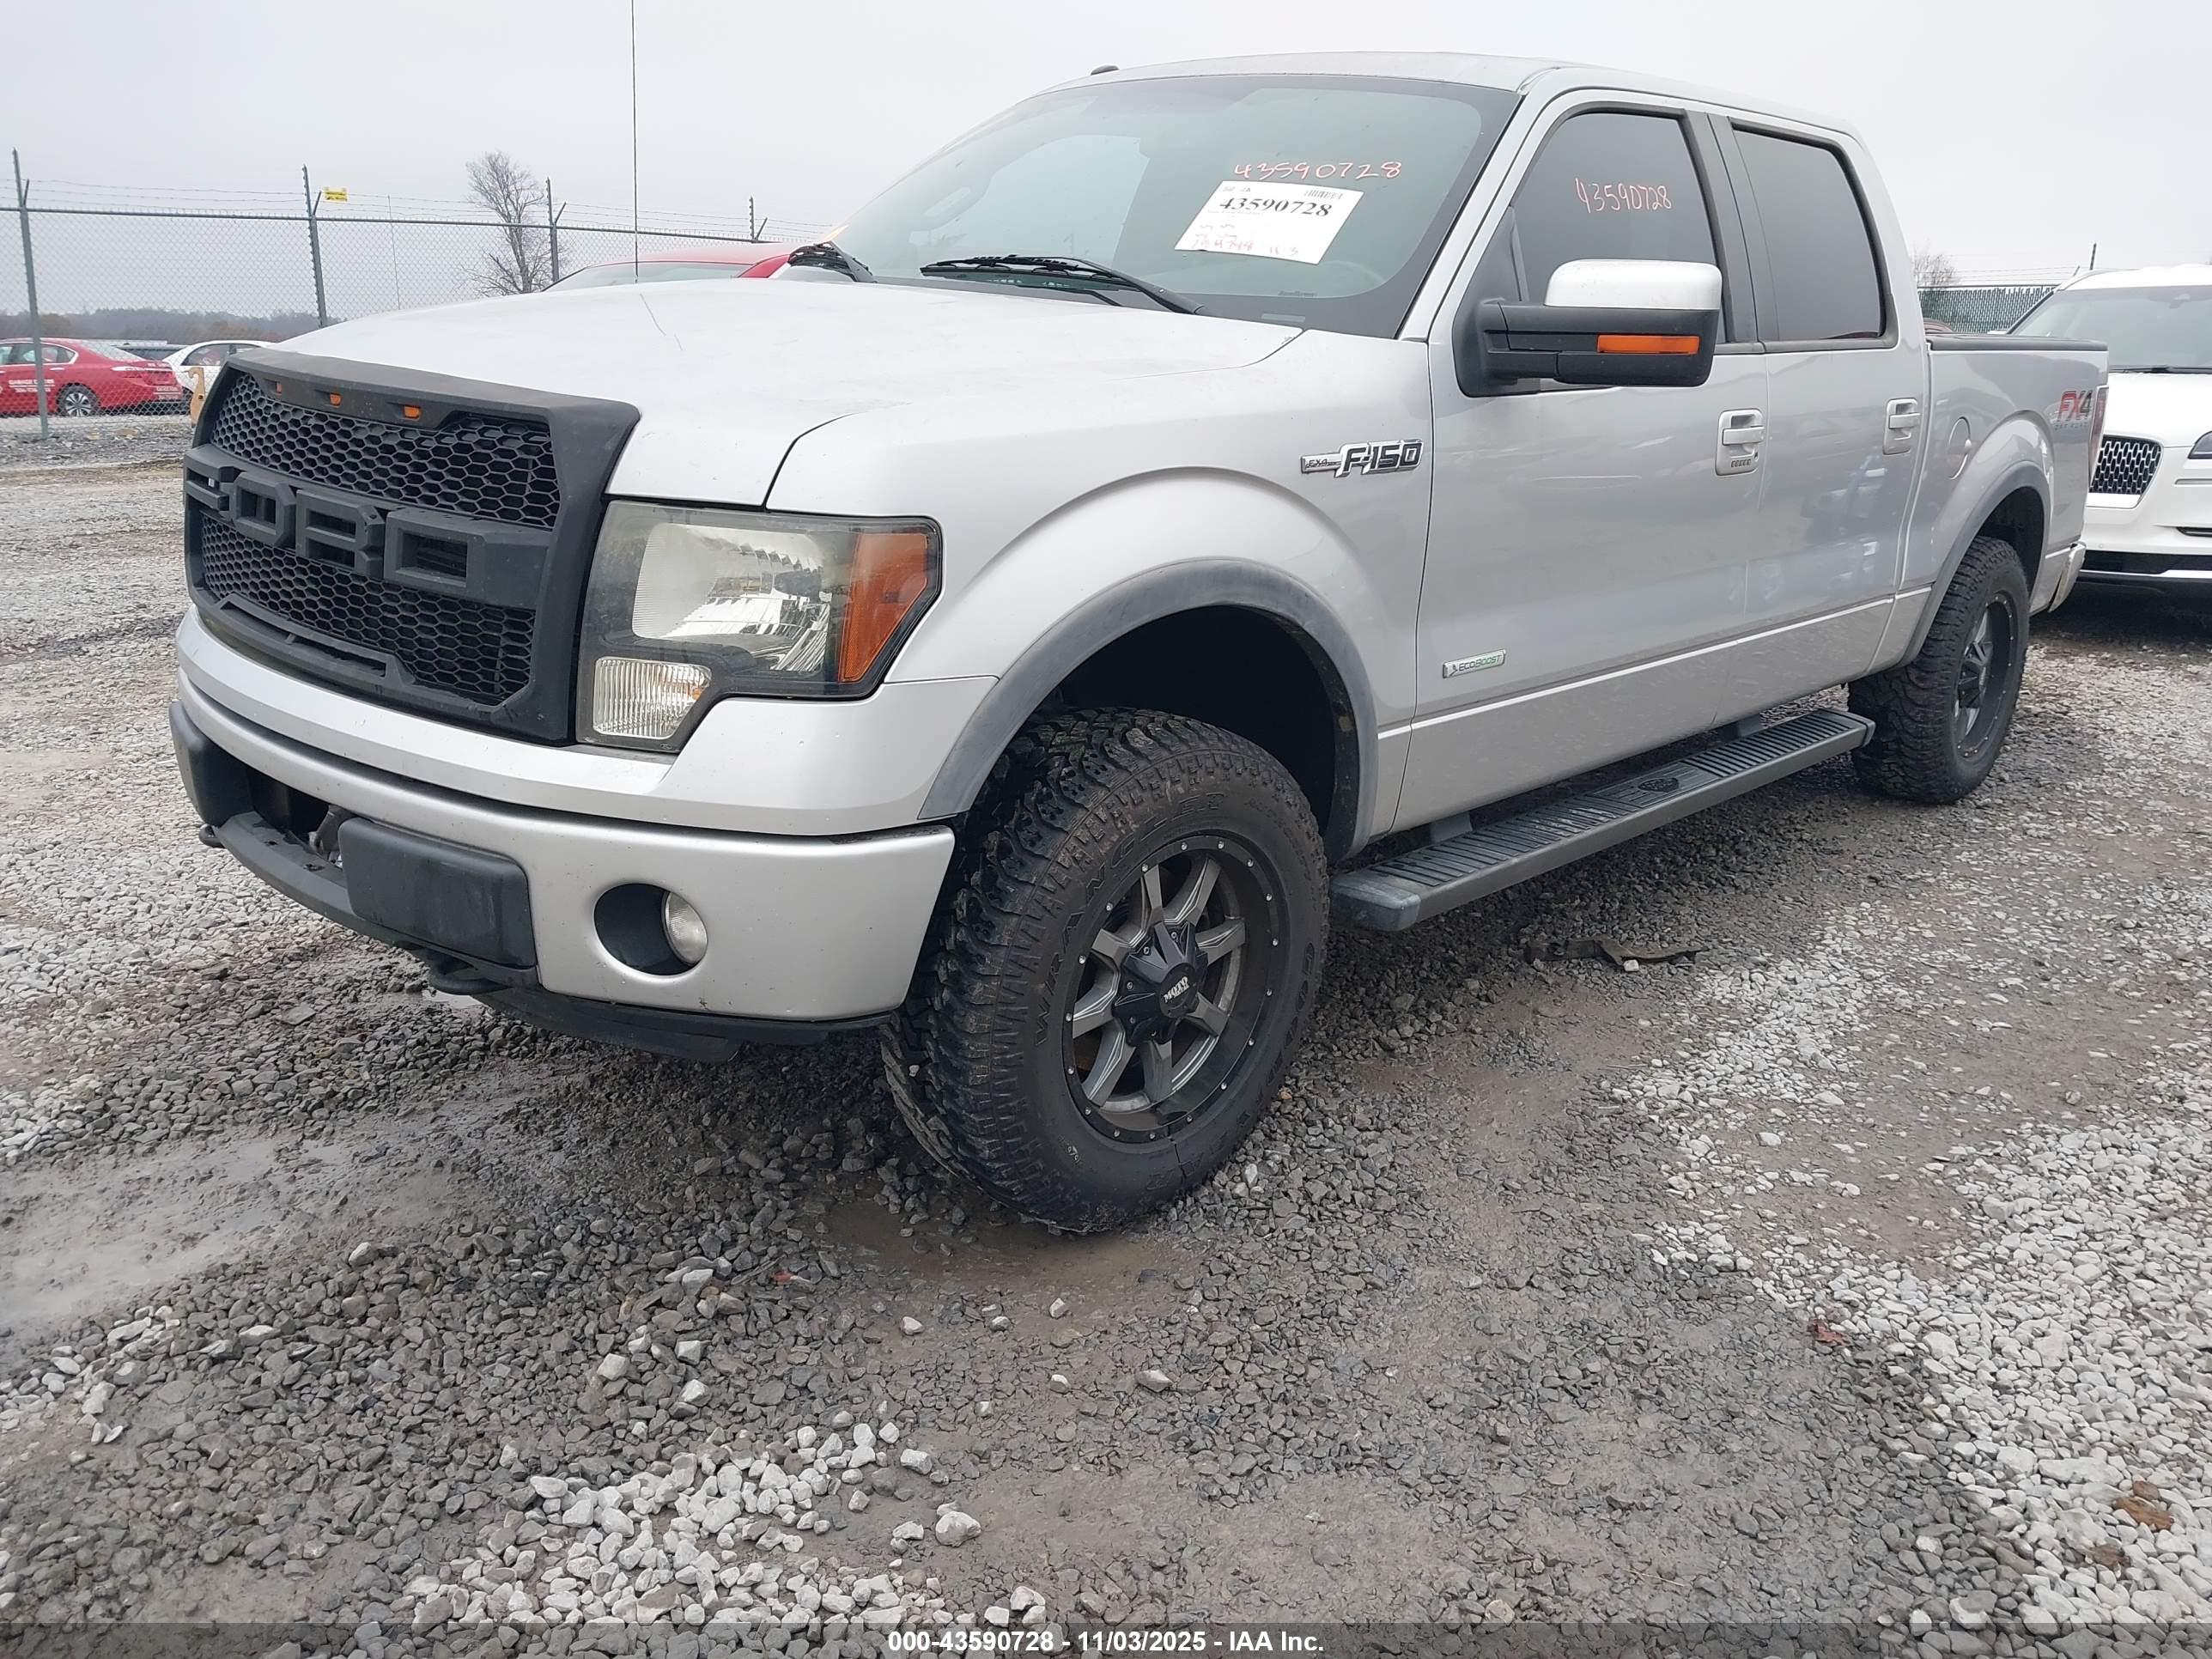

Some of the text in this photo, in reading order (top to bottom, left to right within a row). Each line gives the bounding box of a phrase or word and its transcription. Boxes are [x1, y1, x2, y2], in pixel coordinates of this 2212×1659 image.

[1234, 161, 1402, 180] 43590728
[1219, 197, 1333, 217] 43590728
[1575, 178, 1672, 214] 43590728
[2057, 390, 2093, 420] FX4
[1335, 439, 1424, 477] F-150
[1458, 654, 1503, 672] ECOBOOST
